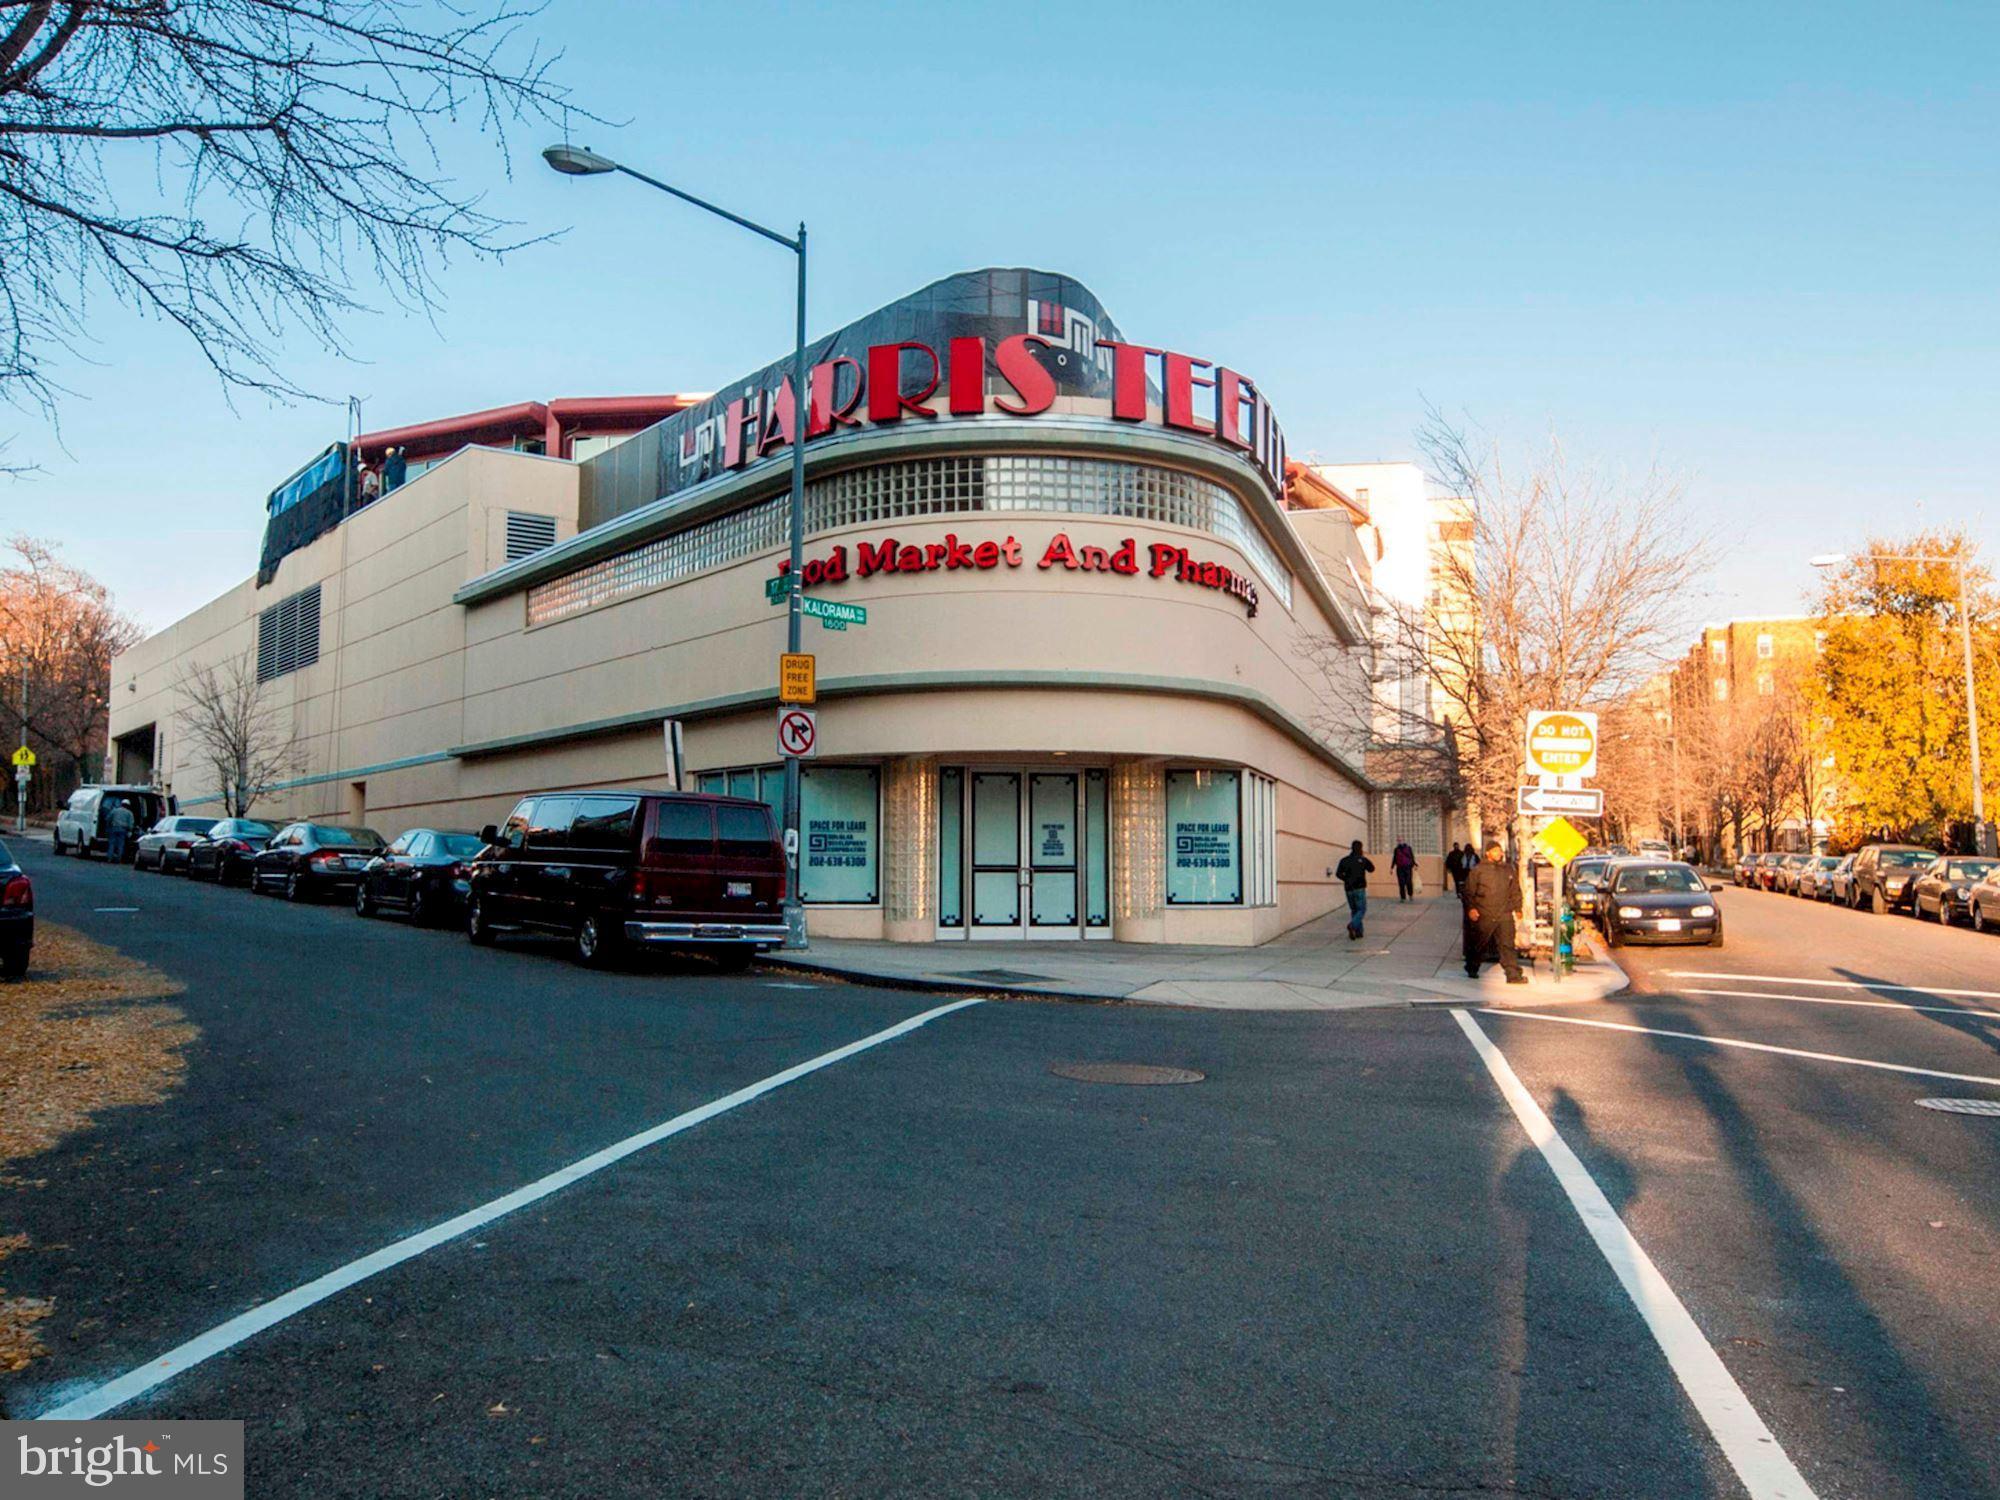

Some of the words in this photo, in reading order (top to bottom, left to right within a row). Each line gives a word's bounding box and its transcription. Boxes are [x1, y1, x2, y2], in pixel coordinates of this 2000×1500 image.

[724, 333, 1056, 470] HARRIS
[776, 545, 849, 586] Fod
[857, 534, 1022, 577] Market
[1037, 533, 1139, 575] And
[804, 601, 856, 619] KALORAMA
[786, 660, 809, 669] DRUG
[787, 673, 808, 682] FREE
[787, 686, 808, 695] ZONE
[1538, 725, 1555, 736] DO
[1561, 726, 1585, 737] NOT
[1542, 752, 1580, 764] ENTER
[809, 821, 830, 831] SPACE
[832, 821, 845, 831] FOR
[847, 821, 866, 831] LEASE
[1177, 823, 1195, 832] SPACE
[1198, 823, 1209, 832] FOR
[1211, 823, 1229, 832] LEASE
